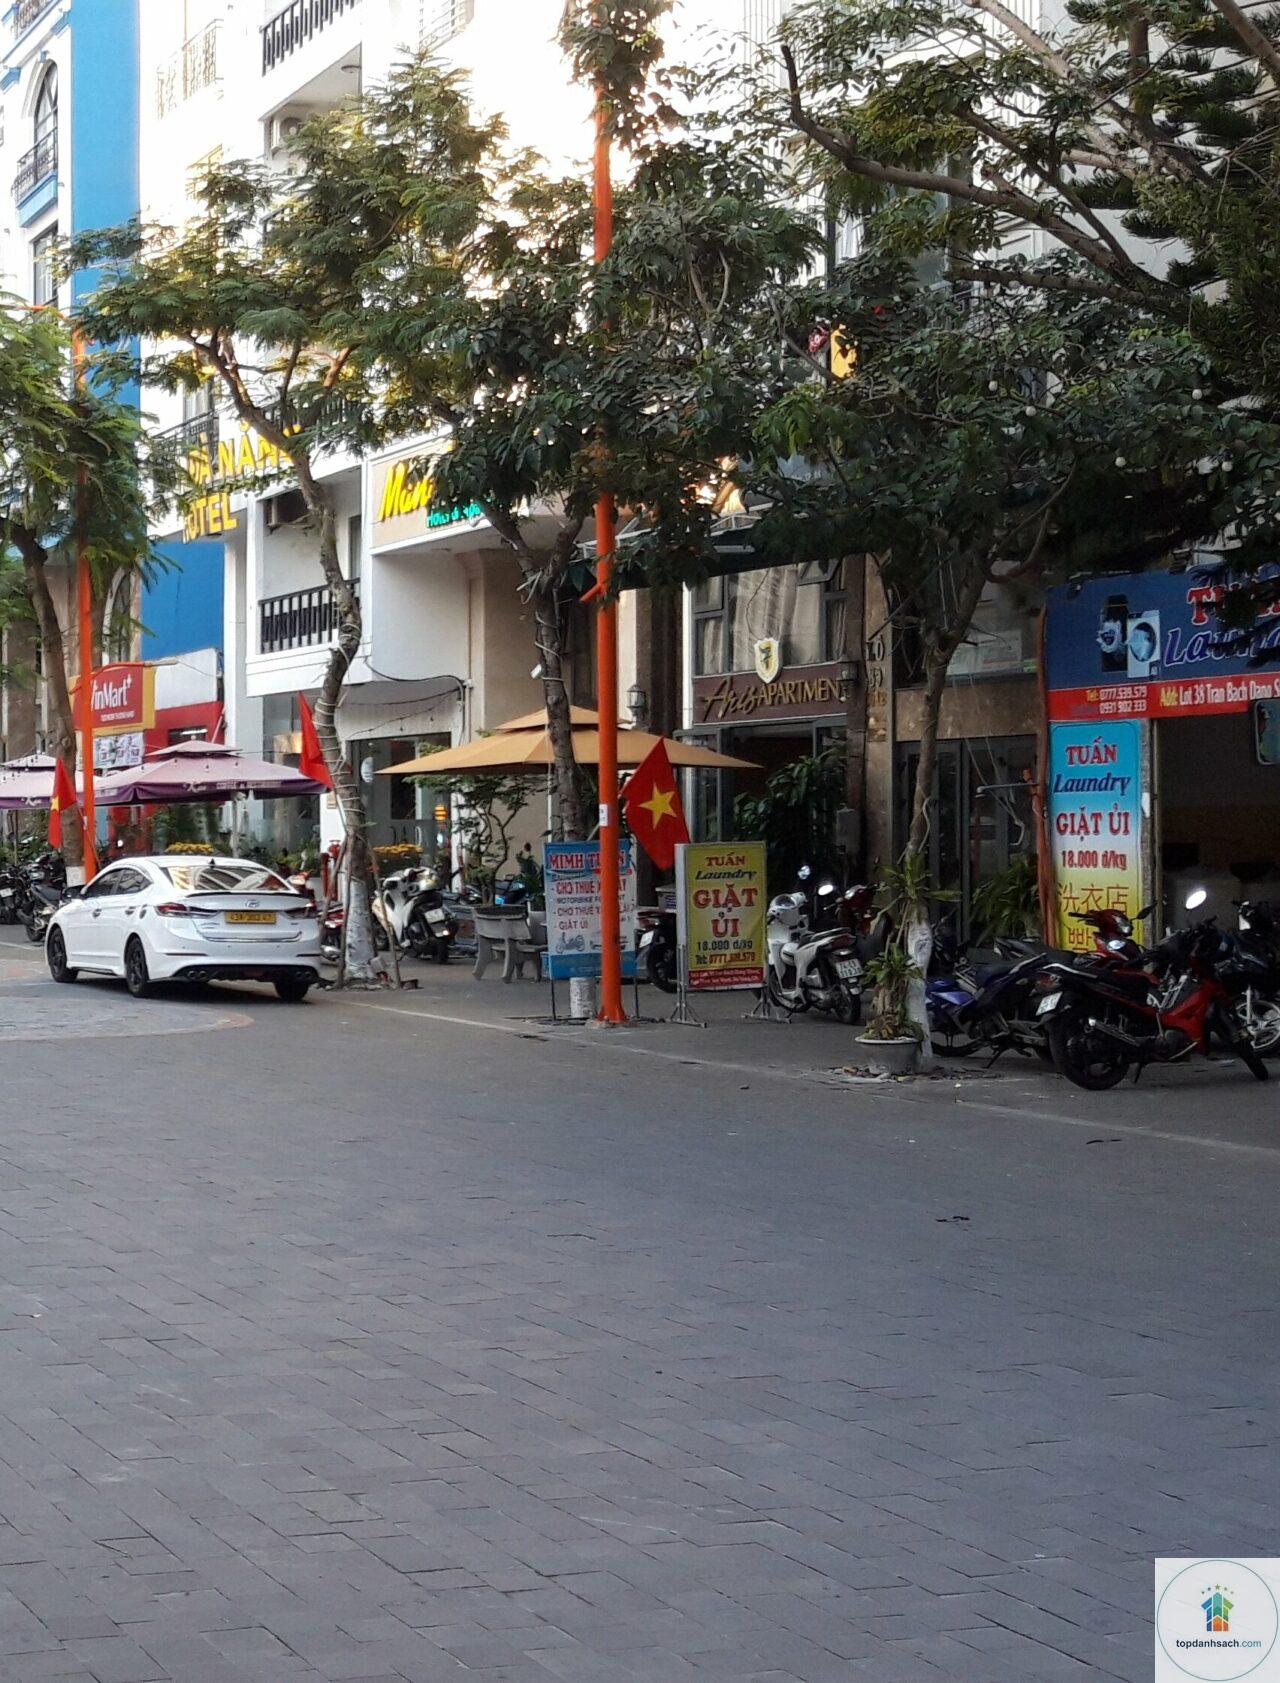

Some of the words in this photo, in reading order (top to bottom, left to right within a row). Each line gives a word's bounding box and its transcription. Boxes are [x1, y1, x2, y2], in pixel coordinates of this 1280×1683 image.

[758, 678, 841, 706] APARTMEN
[1066, 736, 1117, 766] TUẤN
[1053, 772, 1132, 797] Laundry
[1056, 806, 1103, 842] GIẶT
[1108, 803, 1131, 836] ỦI
[705, 852, 746, 867] TUẤN
[695, 869, 757, 881] Laundry
[693, 883, 758, 913] GIẶT
[711, 911, 740, 938] ỦI
